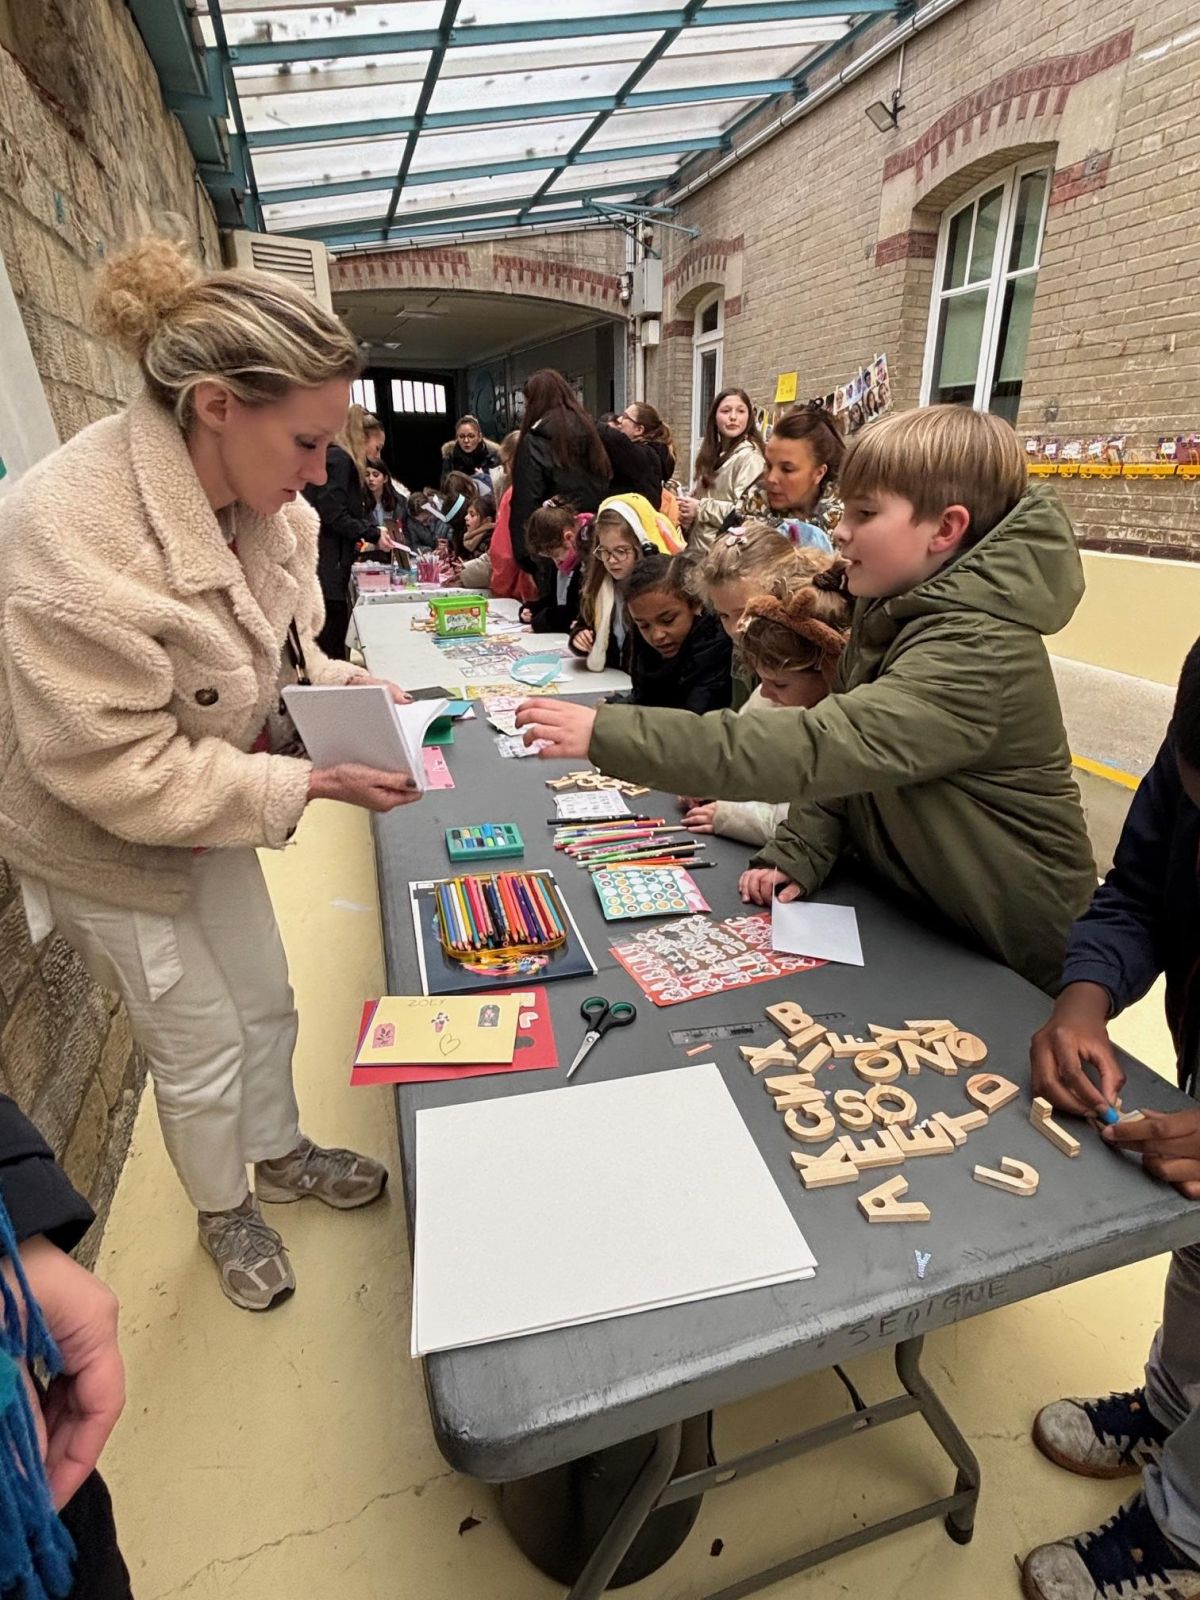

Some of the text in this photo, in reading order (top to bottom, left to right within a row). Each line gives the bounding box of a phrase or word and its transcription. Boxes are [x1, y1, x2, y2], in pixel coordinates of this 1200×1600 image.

[765, 1001, 814, 1037] B
[739, 1039, 797, 1075] X
[854, 1050, 902, 1084] O
[897, 1039, 958, 1076] N
[834, 1089, 874, 1131] S
[966, 1073, 1020, 1114] D
[837, 1134, 905, 1170] E
[887, 1123, 955, 1158] E
[790, 1141, 859, 1189] K
[973, 1156, 1040, 1197] U
[857, 1174, 931, 1223] A
